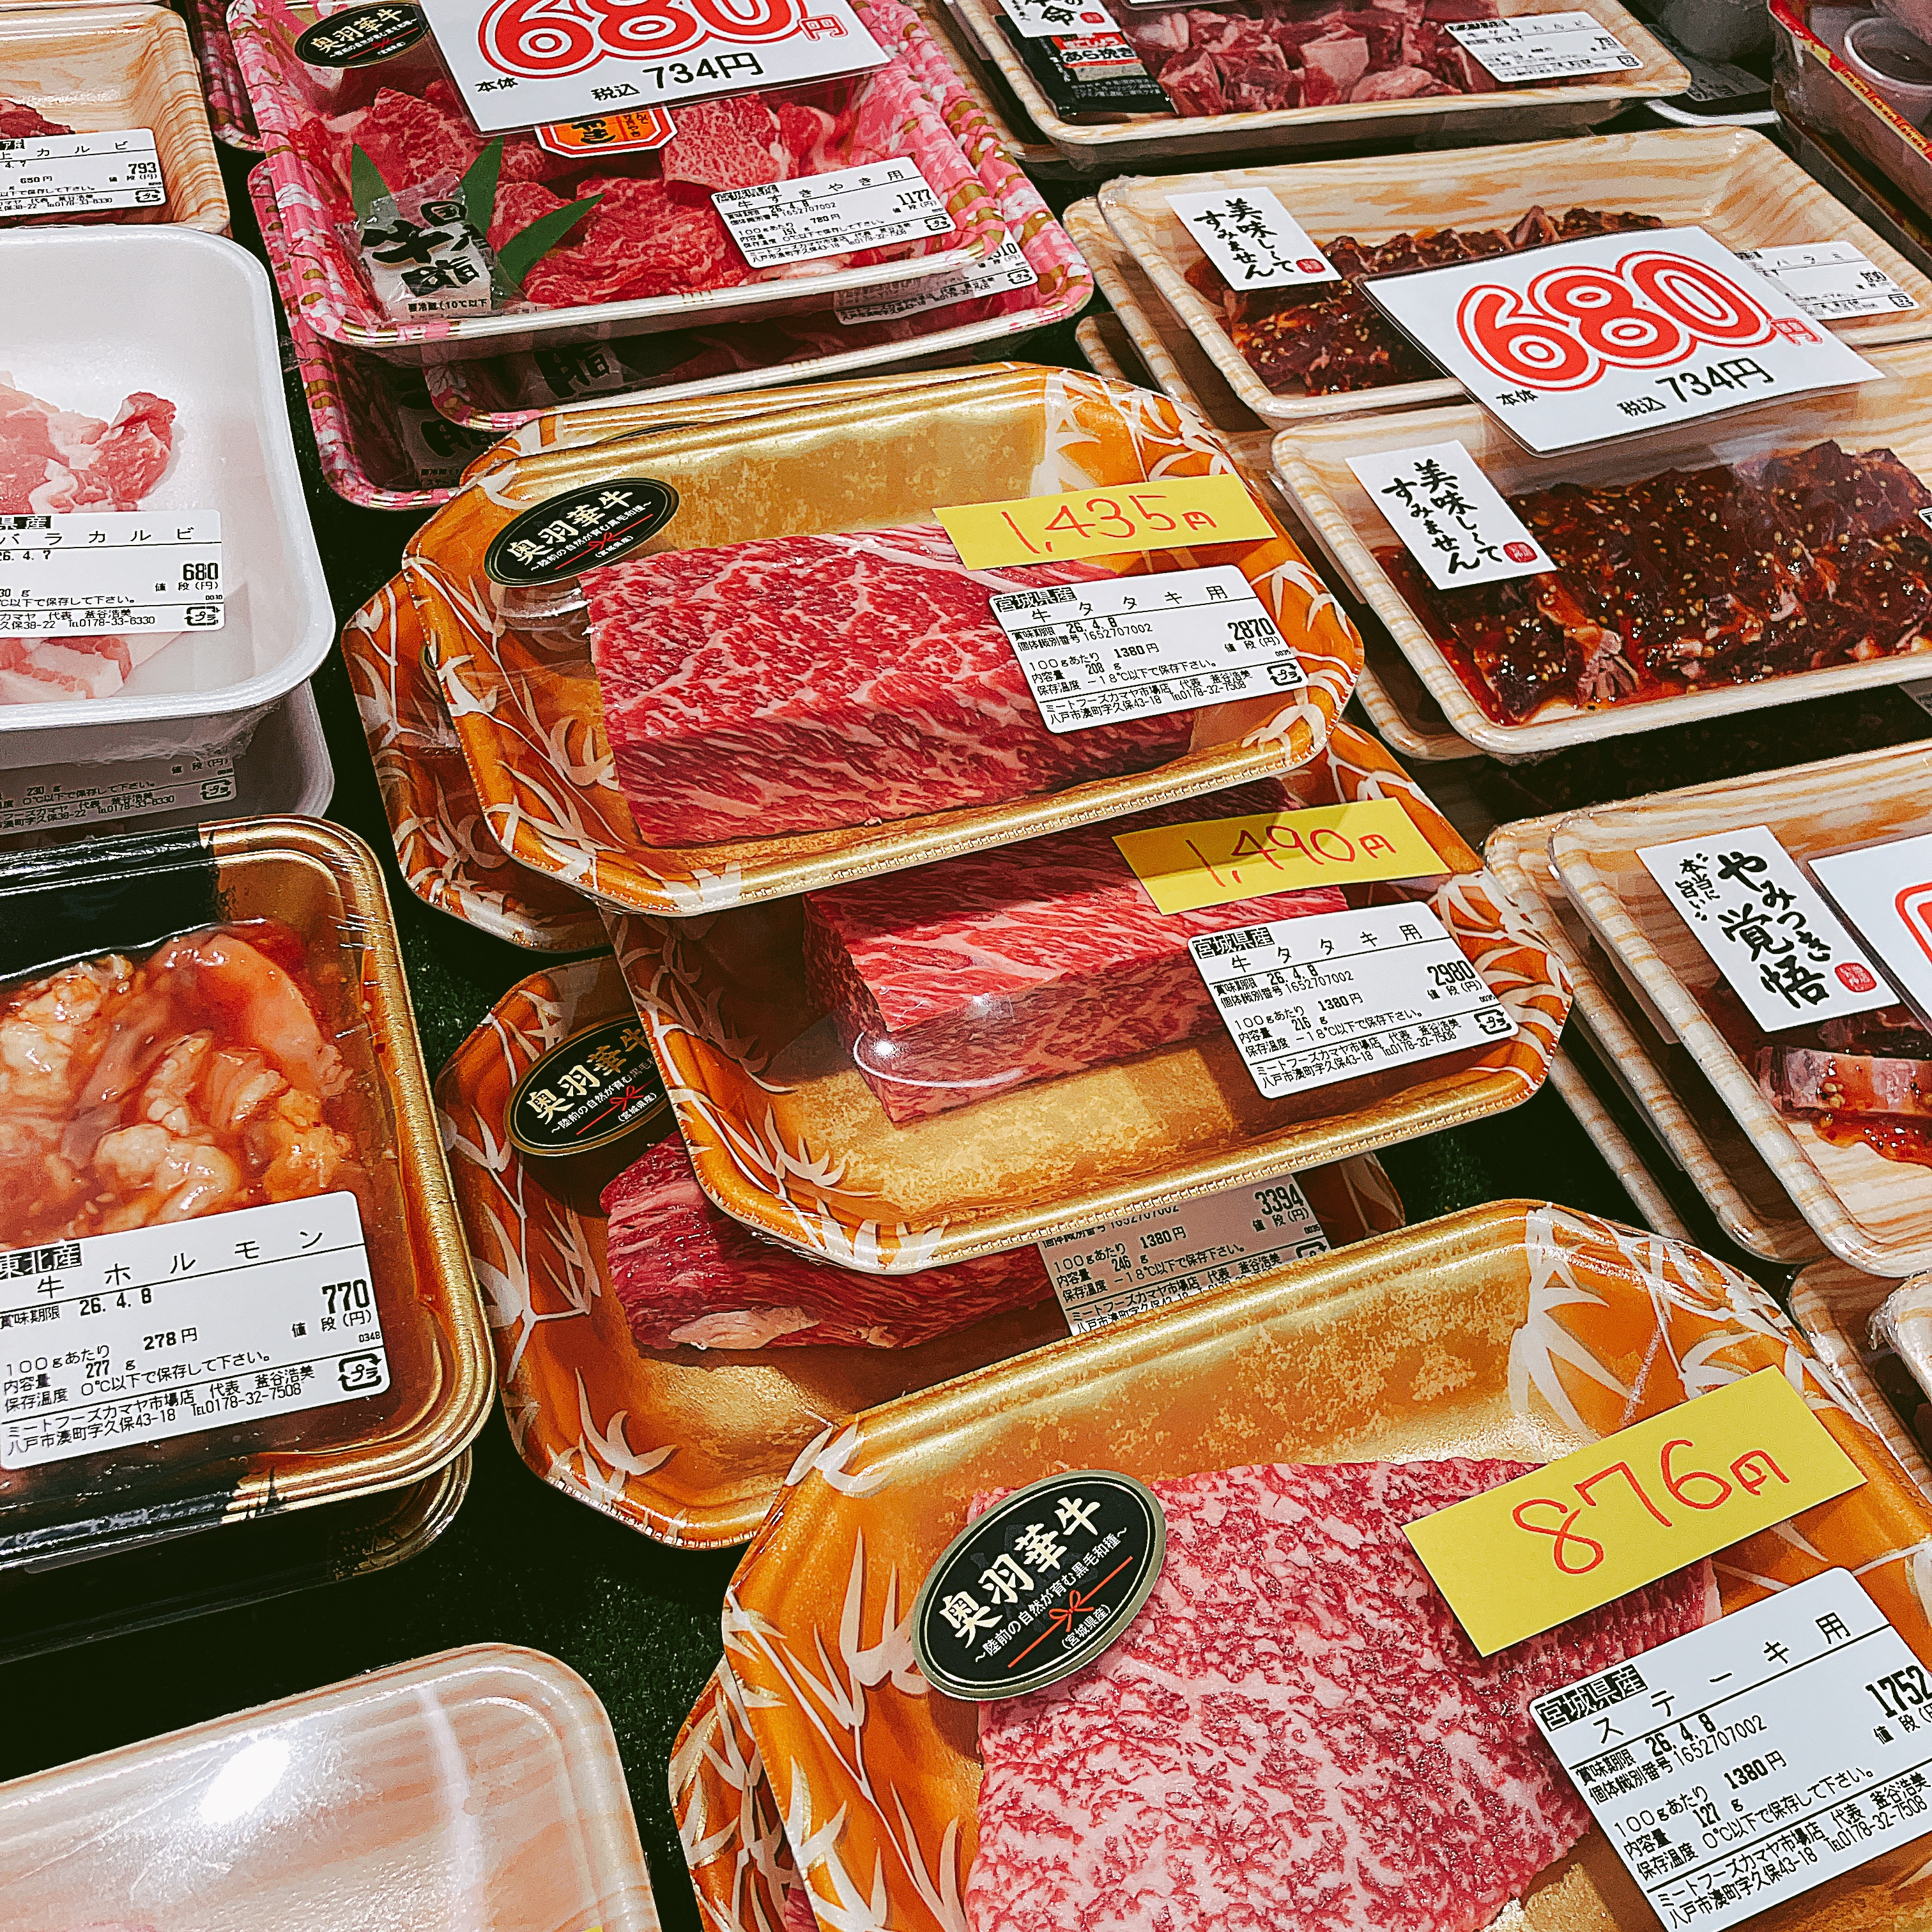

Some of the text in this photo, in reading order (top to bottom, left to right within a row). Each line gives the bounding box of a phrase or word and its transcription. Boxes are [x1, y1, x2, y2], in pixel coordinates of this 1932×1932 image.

[475, 77, 518, 93] 本体
[591, 52, 764, 102] 税込 734円
[128, 162, 157, 174] 793
[896, 188, 932, 206] 1177
[1193, 210, 1274, 280] すみません
[1495, 390, 1538, 407] 本体
[1616, 357, 1775, 417] 税込 734円
[506, 490, 633, 565] 奥羽華牛
[1000, 494, 1218, 555] 1,435円
[1381, 477, 1480, 574] すみません
[1413, 458, 1503, 563] 美味しくて
[183, 562, 218, 581] 680
[993, 586, 1078, 613] 宮城県産
[1018, 624, 1153, 652] 個体識別番号 1652707002
[1227, 617, 1276, 641] 2870
[1114, 643, 1160, 659] 1380円
[1032, 670, 1066, 684] 内容量
[1085, 663, 1105, 675] 208
[1037, 680, 1082, 696] 保存温度
[1180, 678, 1202, 690] 代表
[27, 786, 44, 796] 230
[1186, 825, 1396, 887] 1,490円
[1717, 851, 1832, 963] やみつき
[1192, 926, 1275, 960] 宮城県産
[1717, 902, 1830, 1009] 覚悟
[1214, 977, 1258, 997] 賞味期限
[1220, 970, 1354, 1009] 個体識別番号 1652707002
[1427, 960, 1476, 986] 2980
[1317, 992, 1364, 1012] 1380円
[1238, 1027, 1273, 1045] 内容量
[1292, 1016, 1312, 1031] 216
[1245, 1038, 1291, 1057] 保存温度
[1388, 1029, 1413, 1044] 代表
[526, 1027, 652, 1125] 奥羽華牛
[1254, 1183, 1304, 1216] 3394
[1140, 1225, 1187, 1250] 1380円
[0, 1243, 82, 1279] 東北産
[37, 1230, 323, 1299] 牛ホルモン
[1057, 1268, 1092, 1289] 内容量
[1114, 1258, 1132, 1273] 246
[1208, 1266, 1230, 1284] 代表
[322, 1278, 371, 1315] 770
[1062, 1278, 1108, 1303] 保存温度
[0, 1305, 61, 1330] 賞味期限
[143, 1327, 198, 1351] 278円
[4, 1374, 51, 1395] 内容量
[85, 1359, 109, 1379] 277
[210, 1379, 241, 1399] 代表
[254, 1365, 316, 1390] 釜谷浩美
[5, 1388, 68, 1414] 保存温度
[8, 1407, 176, 1456] 八戸市湊町字久保43-18
[1512, 1438, 1790, 1575] 876円
[939, 1496, 1101, 1649] 奥羽華牛
[1593, 1612, 1851, 1744] ステーキ用
[1865, 1665, 1932, 1719] 1752
[1534, 1664, 1649, 1733] 宮城県産
[1575, 1748, 1637, 1787] 賞味期限
[1588, 1714, 1768, 1805] 個体識別番号 1652707002
[1723, 1750, 1787, 1790] 1380円
[1830, 1802, 1866, 1829] 代表
[1869, 1771, 1931, 1811] 釜谷浩美
[1623, 1828, 1673, 1861] 内容量
[1692, 1802, 1722, 1828] 127
[1636, 1842, 1699, 1882] 保存温度
[1669, 1846, 1818, 1929] 八戸市湊町字久保43-18
